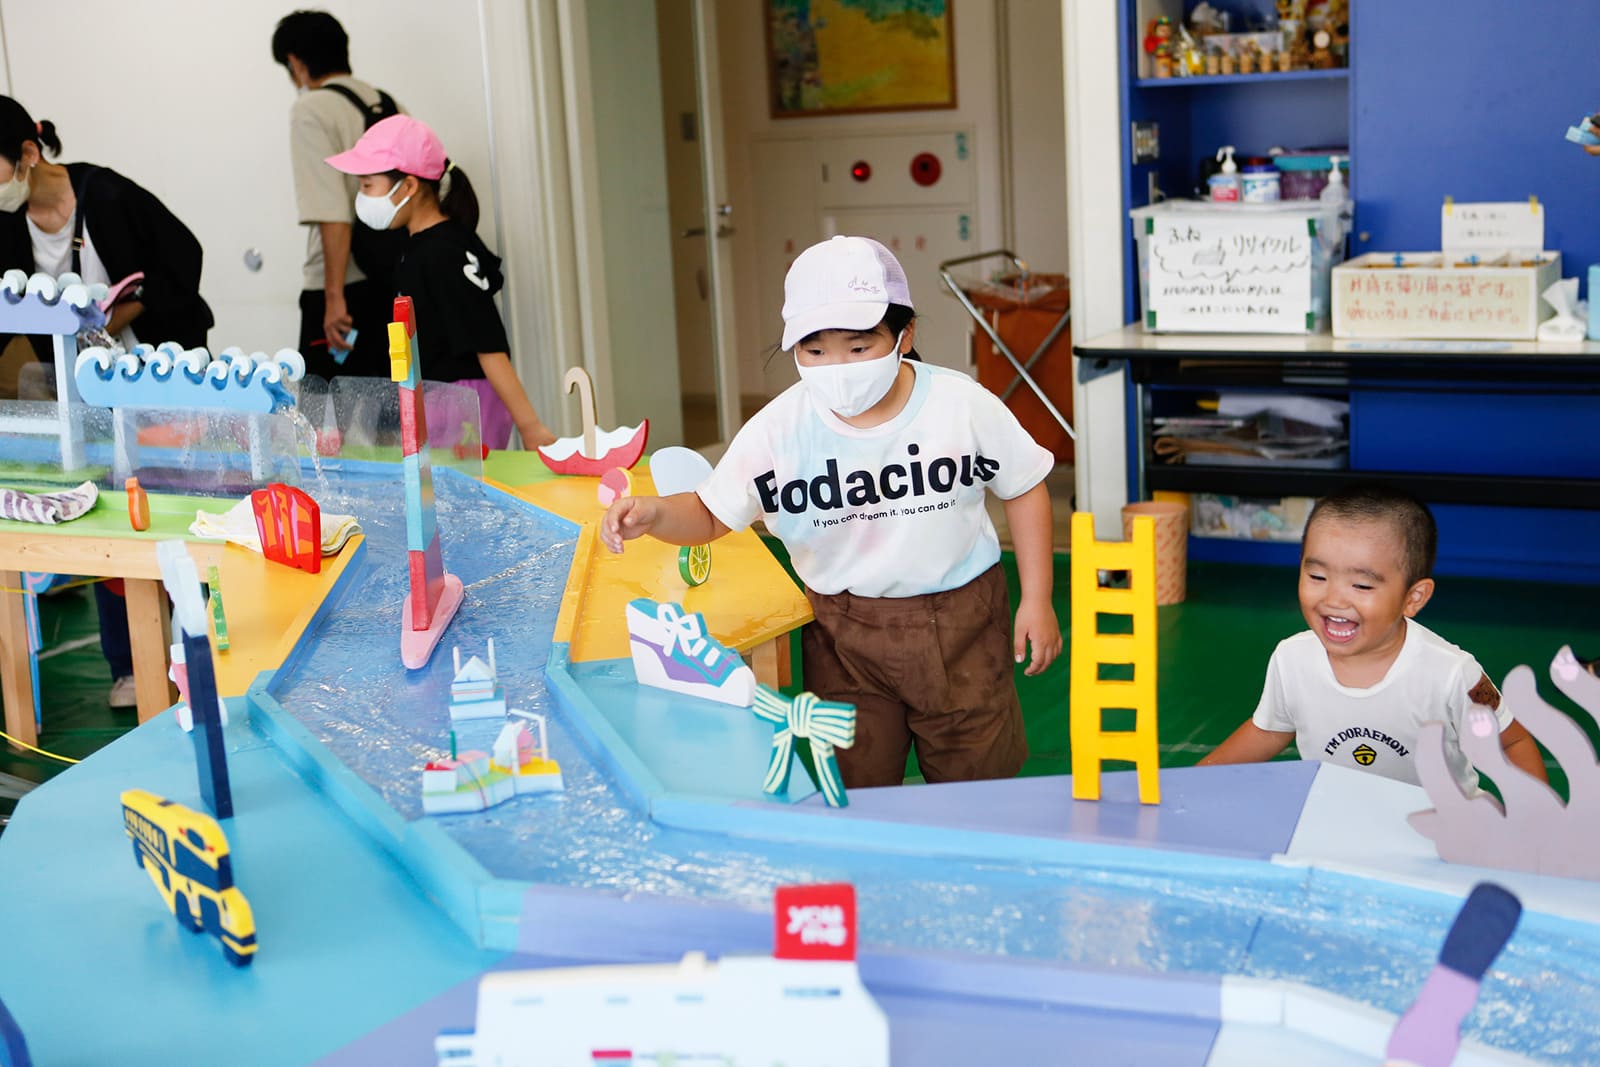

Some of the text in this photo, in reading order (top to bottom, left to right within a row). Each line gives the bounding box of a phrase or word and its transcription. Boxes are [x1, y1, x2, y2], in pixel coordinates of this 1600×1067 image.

[1233, 235, 1302, 257] リサイクル
[813, 519, 820, 527] If
[822, 519, 839, 528] you
[840, 513, 858, 523] can
[860, 512, 888, 521] dream
[917, 504, 935, 513] can
[937, 501, 950, 510] do
[1325, 727, 1410, 757] I'M DORAEMON
